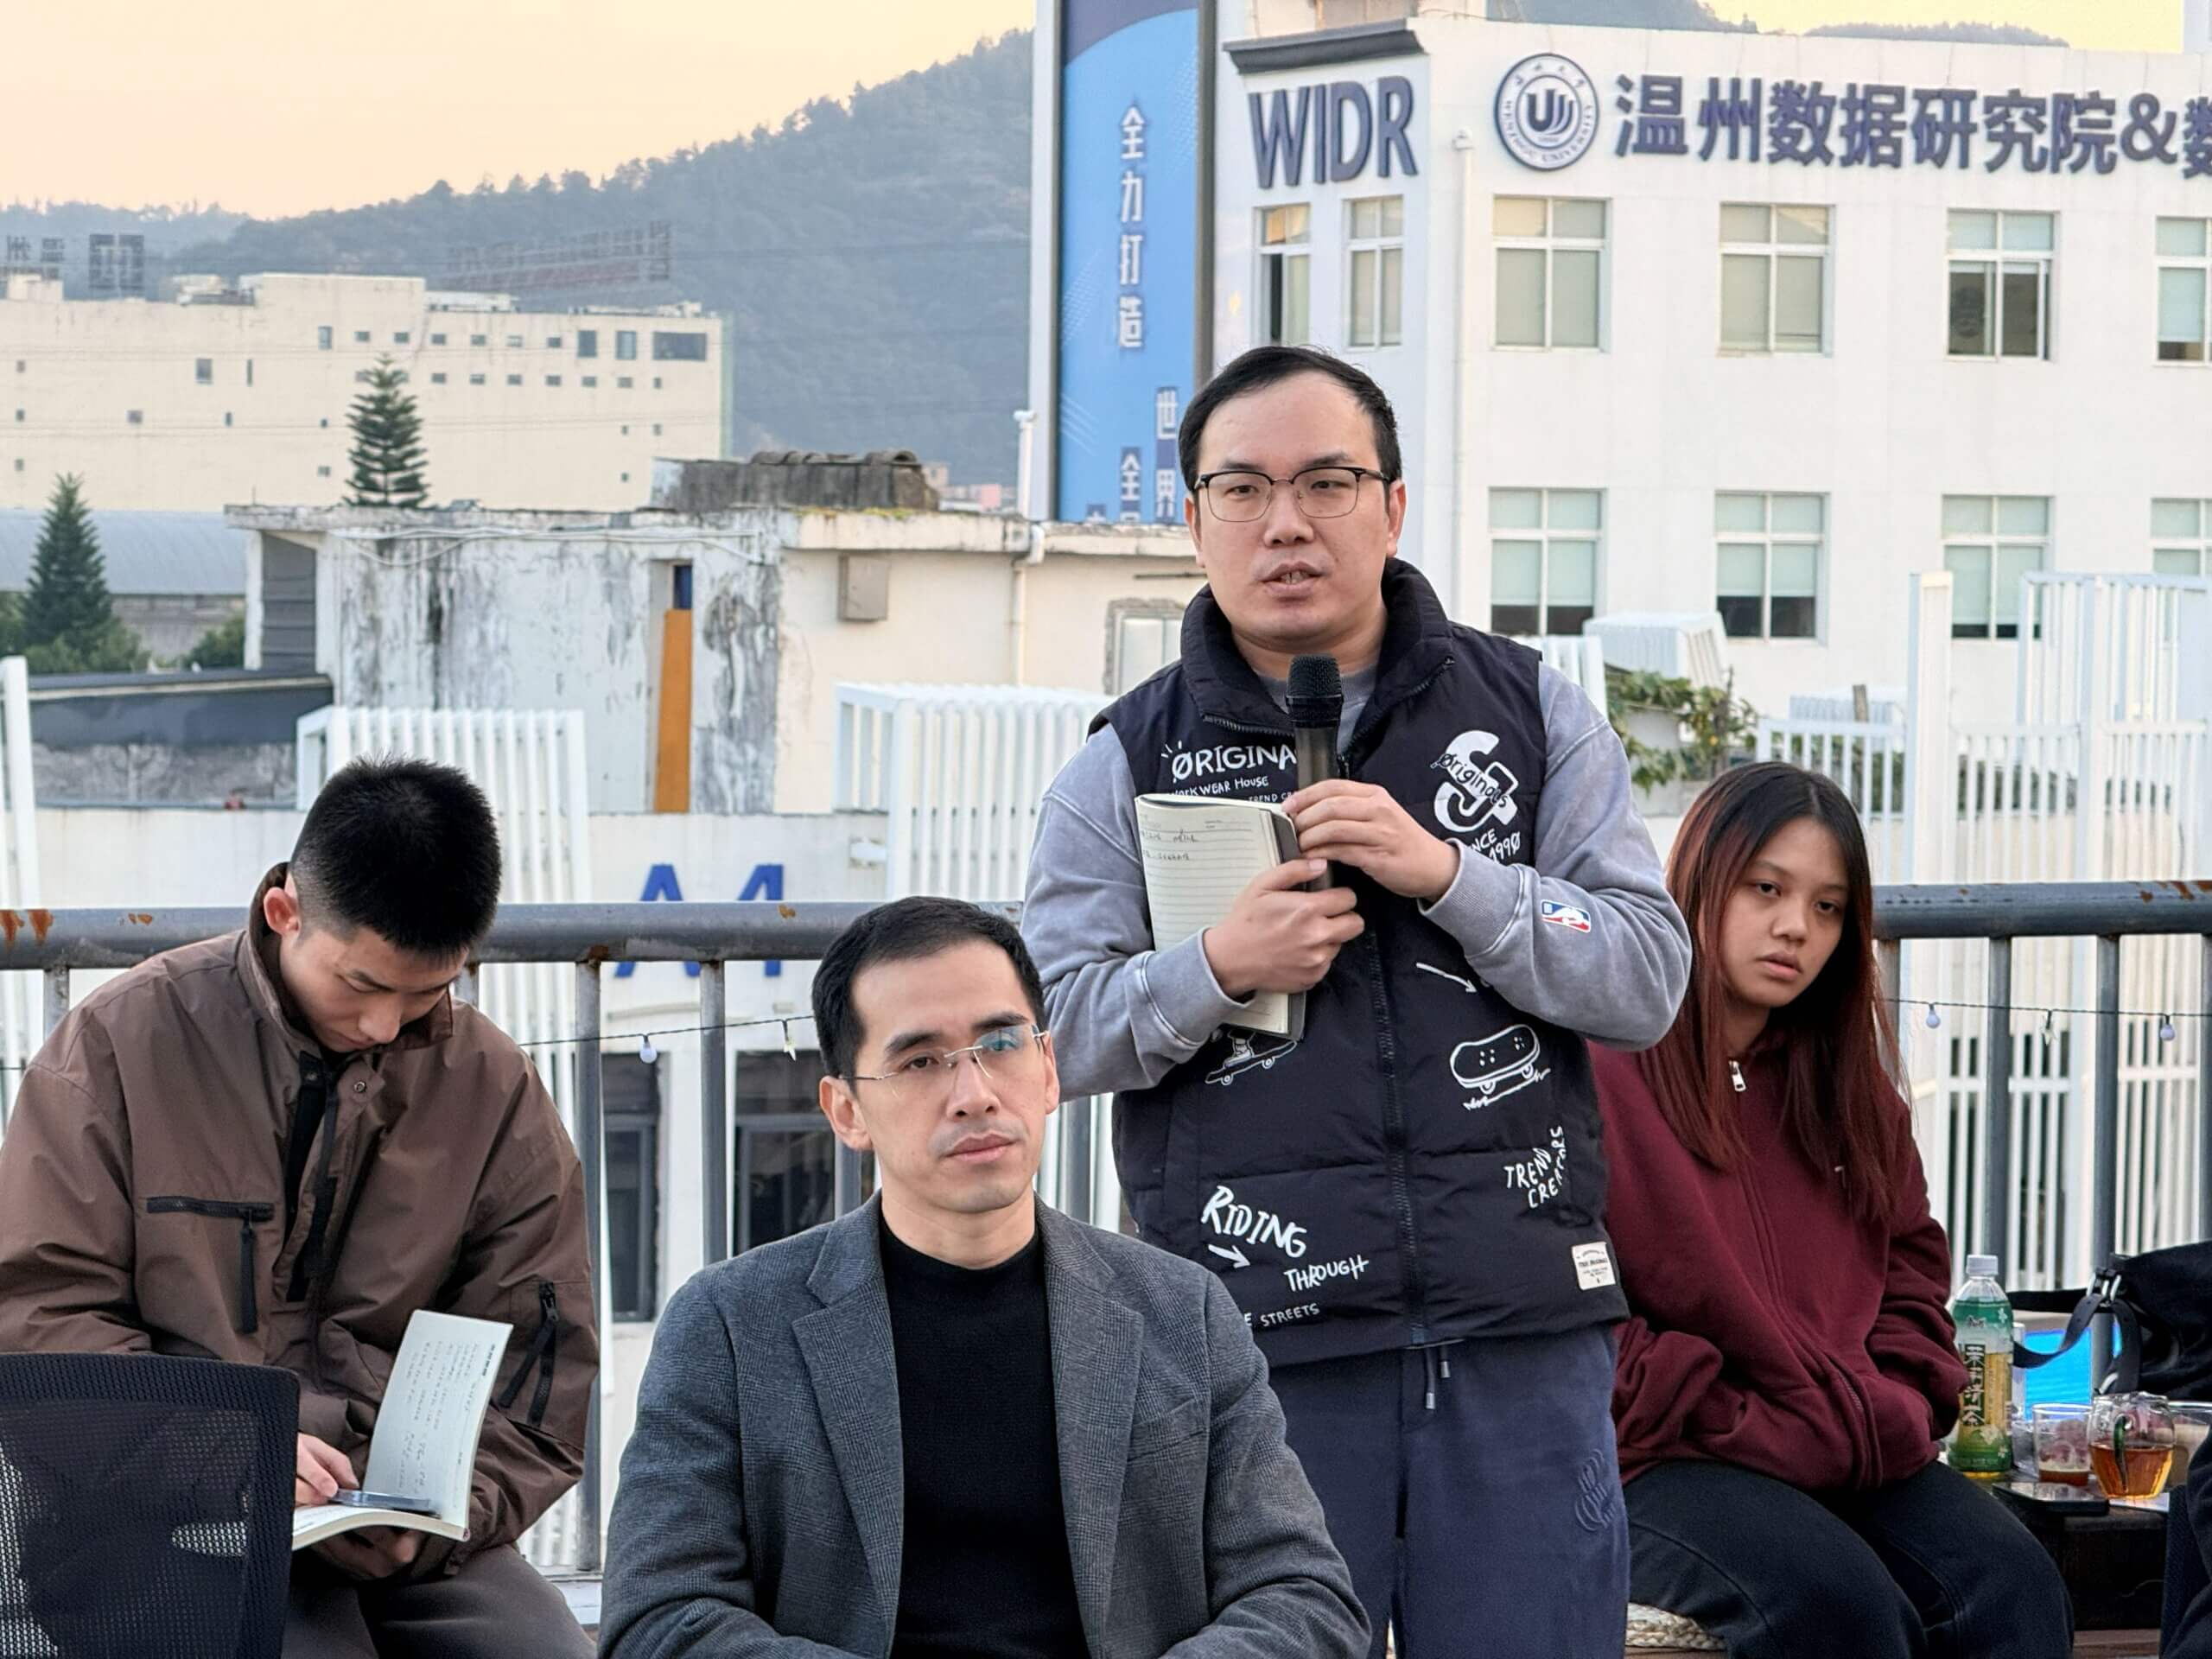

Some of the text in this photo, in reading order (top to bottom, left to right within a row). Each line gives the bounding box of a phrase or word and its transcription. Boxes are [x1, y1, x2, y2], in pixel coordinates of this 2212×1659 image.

[1248, 75, 1419, 190] WIDR
[1119, 105, 1144, 347] 全力打造
[1503, 1147, 1552, 1189] TREND
[1200, 1185, 1307, 1258] RIDING
[1282, 1254, 1370, 1292] THROUGH
[1260, 1302, 1320, 1327] STREETS
